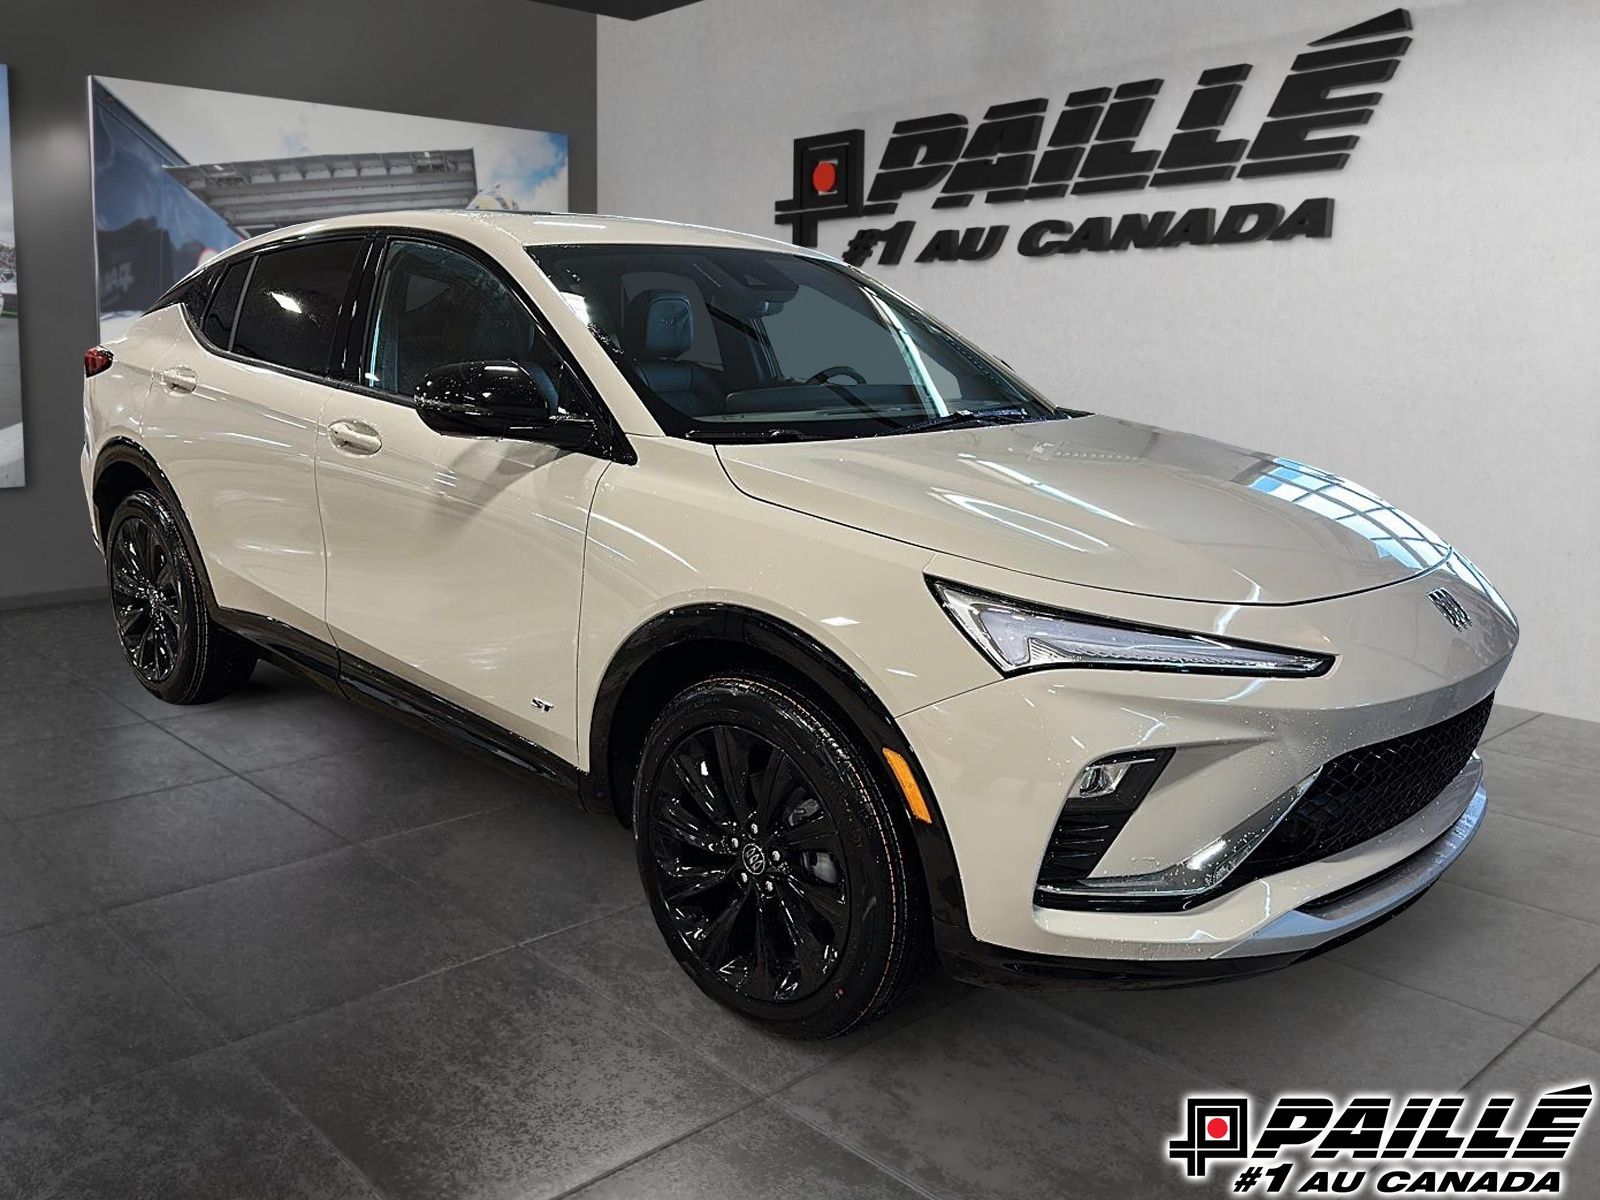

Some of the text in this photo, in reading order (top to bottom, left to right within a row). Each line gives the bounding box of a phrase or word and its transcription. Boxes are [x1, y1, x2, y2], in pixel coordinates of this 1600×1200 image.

[862, 8, 1413, 214] PAILLÉ
[841, 197, 1335, 267] #1 AU CANADA
[530, 697, 554, 712] ST
